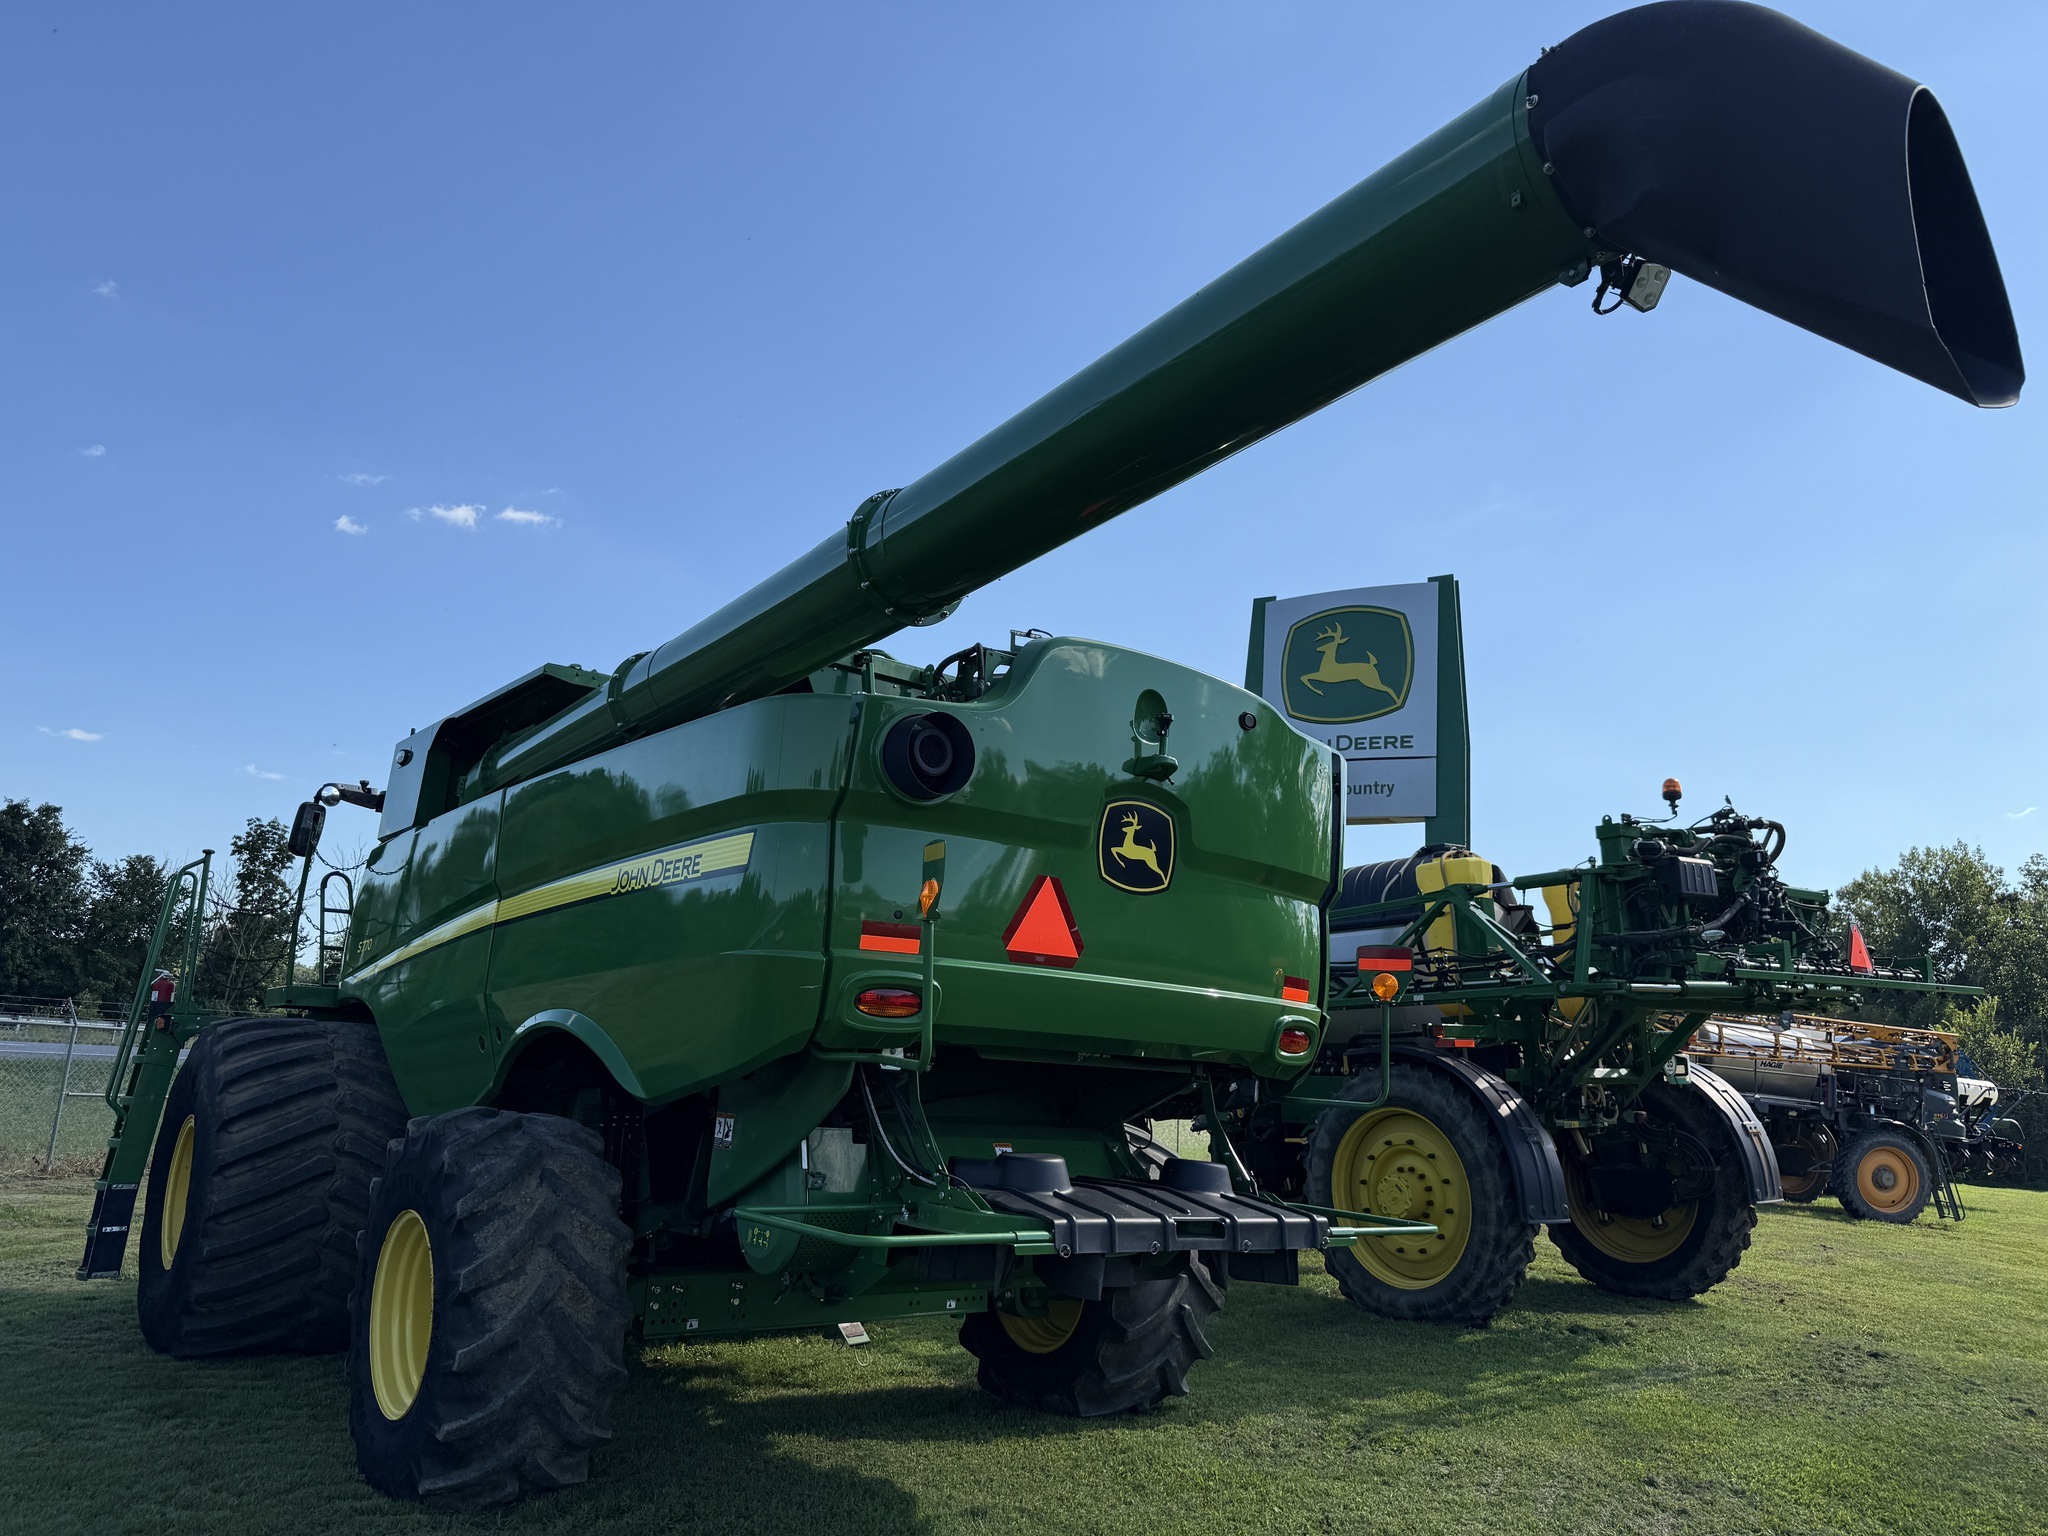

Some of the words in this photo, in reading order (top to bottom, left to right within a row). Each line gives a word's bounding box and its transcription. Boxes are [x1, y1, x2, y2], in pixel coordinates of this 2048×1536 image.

[1335, 734, 1414, 752] DEERE
[1346, 780, 1395, 798] ountry
[611, 865, 650, 892] JOHN
[651, 853, 703, 884] DEERE
[356, 937, 373, 954] S770
[1760, 1060, 1784, 1069] HAGIE
